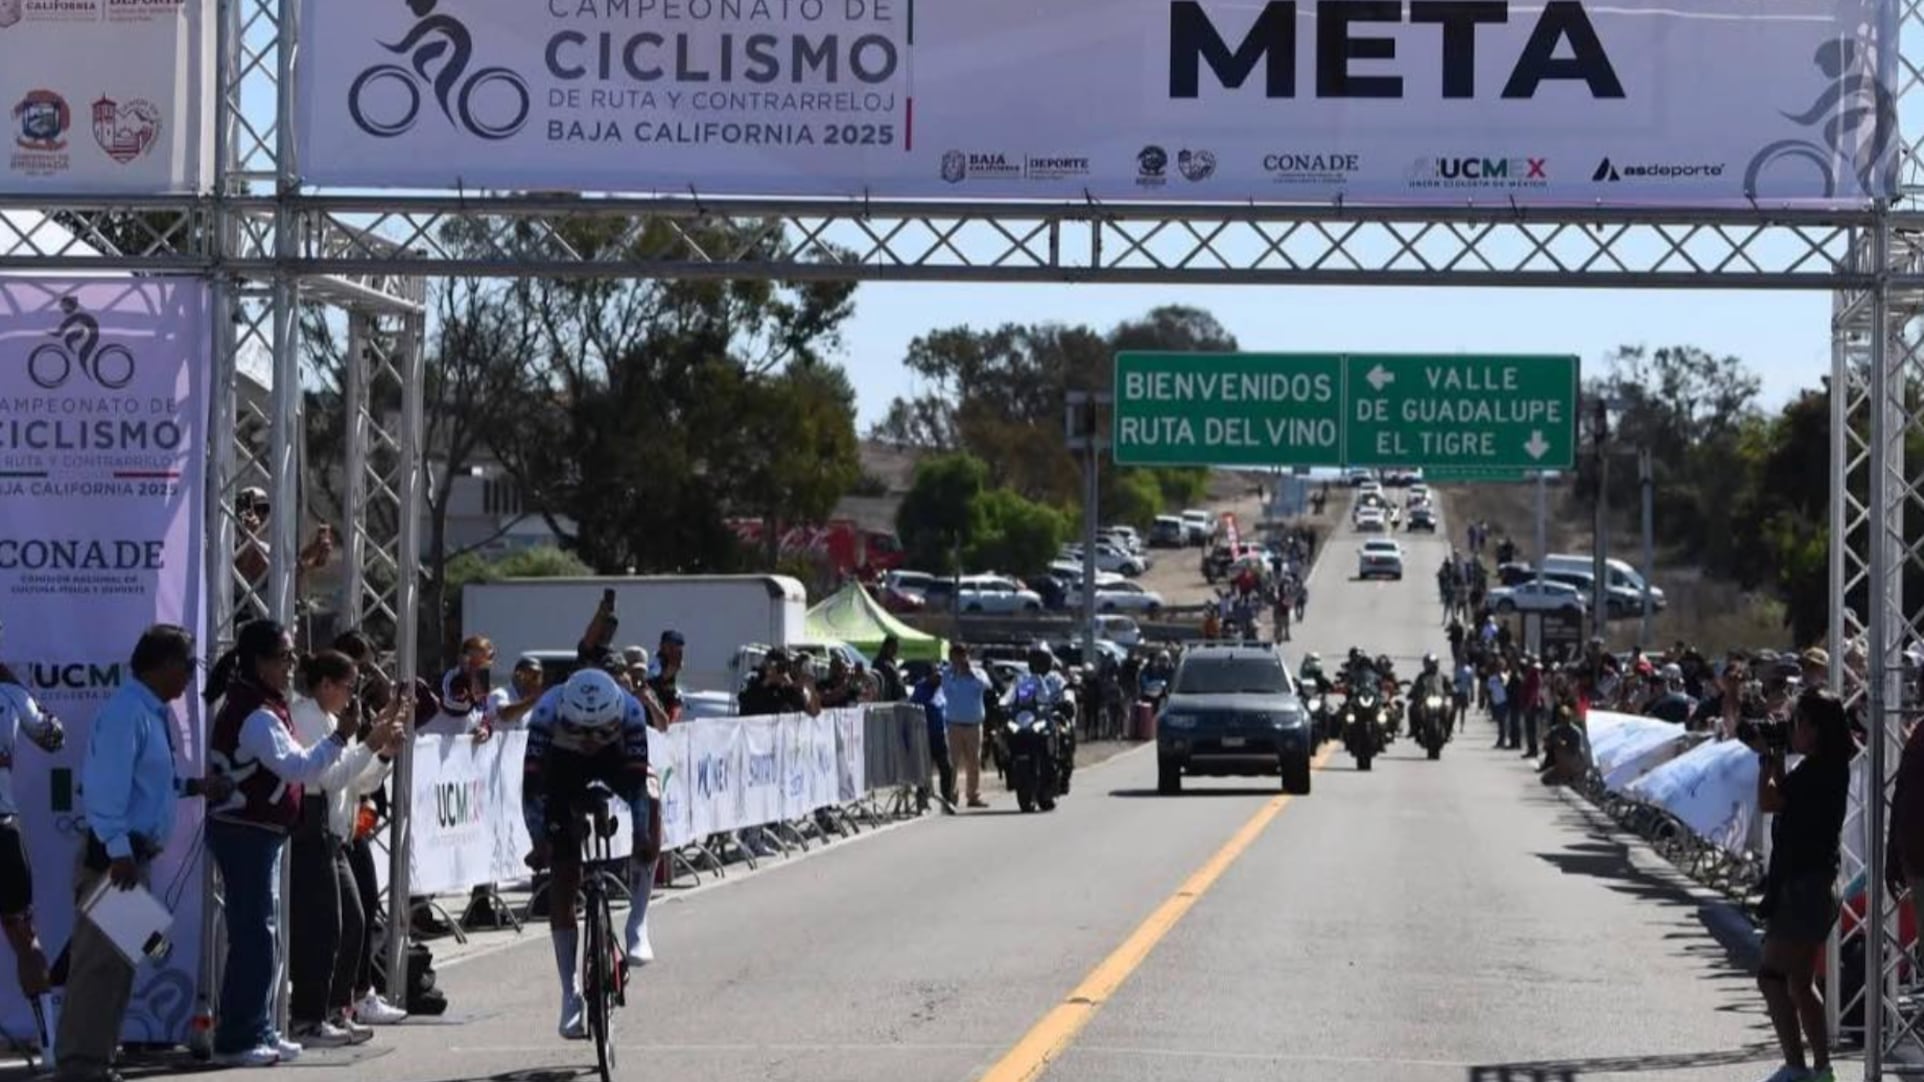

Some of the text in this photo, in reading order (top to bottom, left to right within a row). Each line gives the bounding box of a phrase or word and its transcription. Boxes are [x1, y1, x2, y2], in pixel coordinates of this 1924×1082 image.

[548, 0, 893, 21] CAMPEONATO DE
[545, 30, 898, 83] CICLISMO
[1169, 0, 1626, 99] META
[549, 88, 896, 112] DE RUTA Y CONTRARRELOJ
[547, 120, 894, 145] BAJA CALIFORNIA 2025
[1029, 157, 1088, 169] DEPORTE
[1263, 154, 1359, 172] CONADE
[1624, 162, 1723, 178] asdeporte
[1125, 372, 1332, 402] BIENVENIDOS
[1425, 366, 1519, 391] VALLE
[0, 397, 176, 414] AMPEONATO DE
[1356, 399, 1561, 423] DE GUADALUPE
[0, 420, 181, 450] ICLISMO
[1119, 416, 1337, 447] RUTA DEL VINO
[1376, 431, 1496, 455] EL TIGRE
[0, 481, 24, 497] JA
[30, 481, 134, 497] CALIFORNIA
[0, 539, 165, 570] CONADE
[34, 663, 120, 689] UCM
